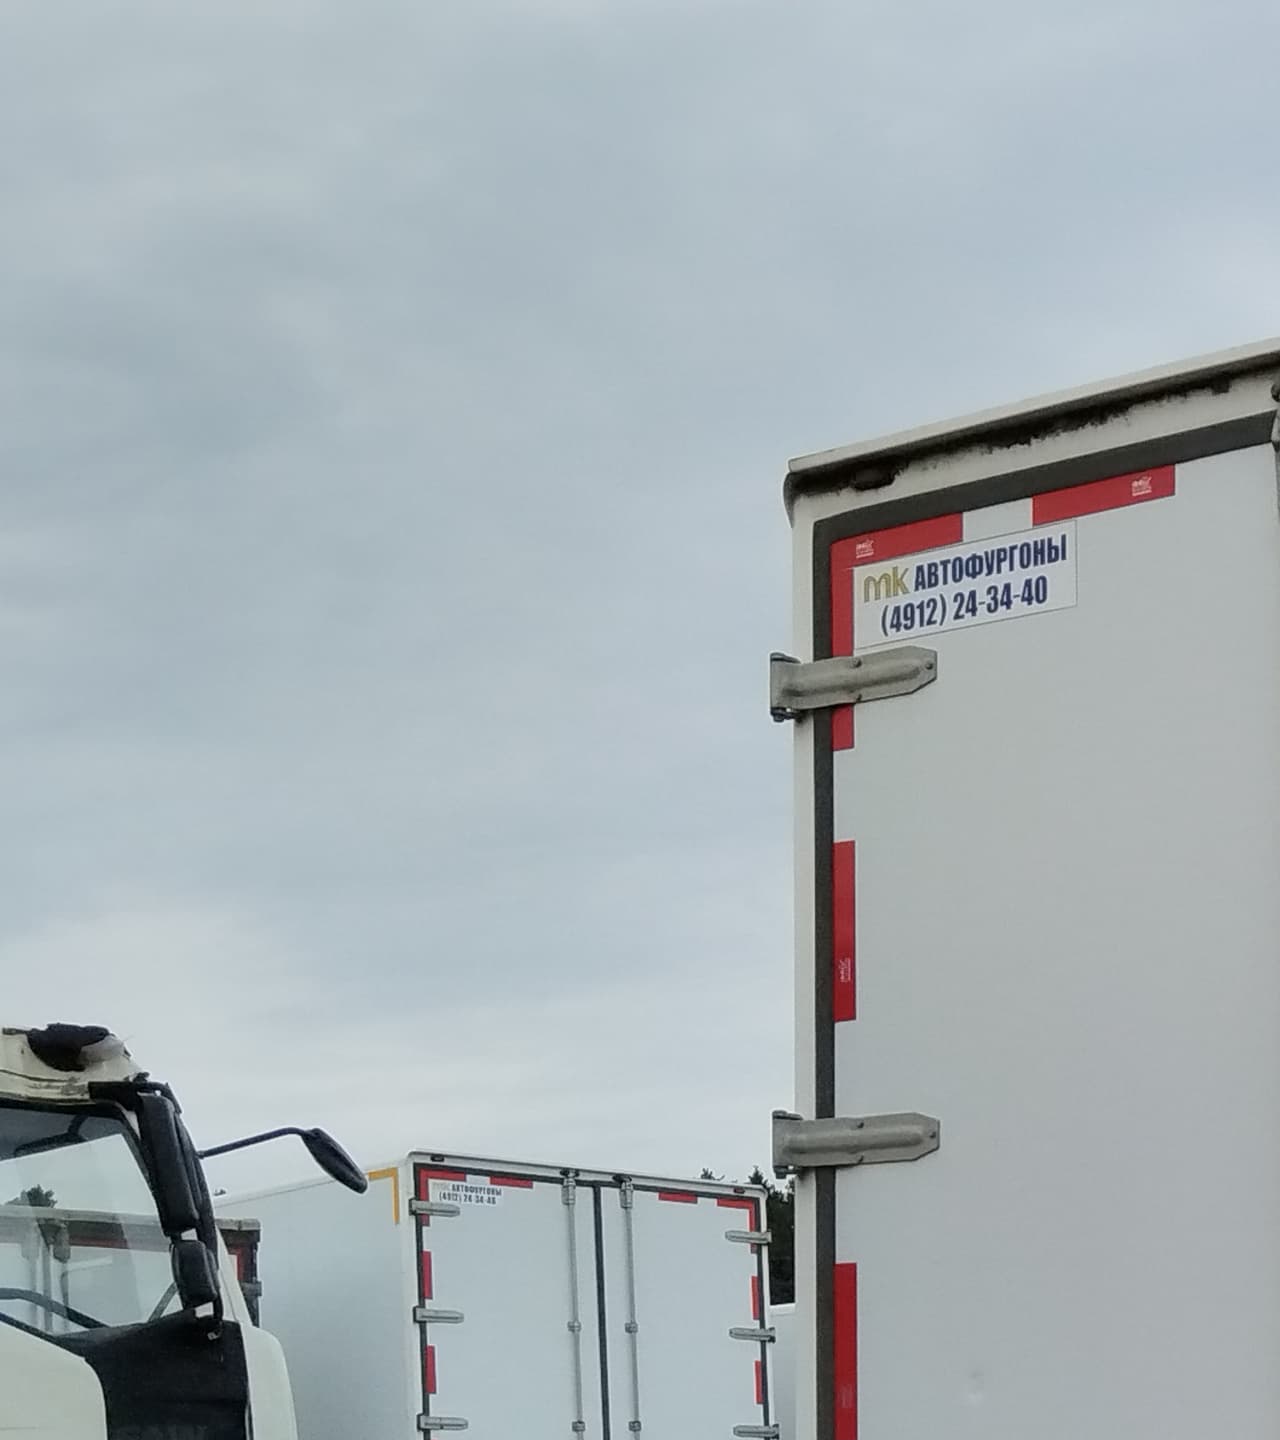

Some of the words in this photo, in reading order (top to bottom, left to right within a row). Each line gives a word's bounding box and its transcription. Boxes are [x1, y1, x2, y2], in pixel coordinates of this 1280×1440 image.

[914, 533, 1068, 593] АВТОФУРГОНЫ
[881, 593, 947, 637] (4912)
[953, 575, 1049, 621] 24-34-40
